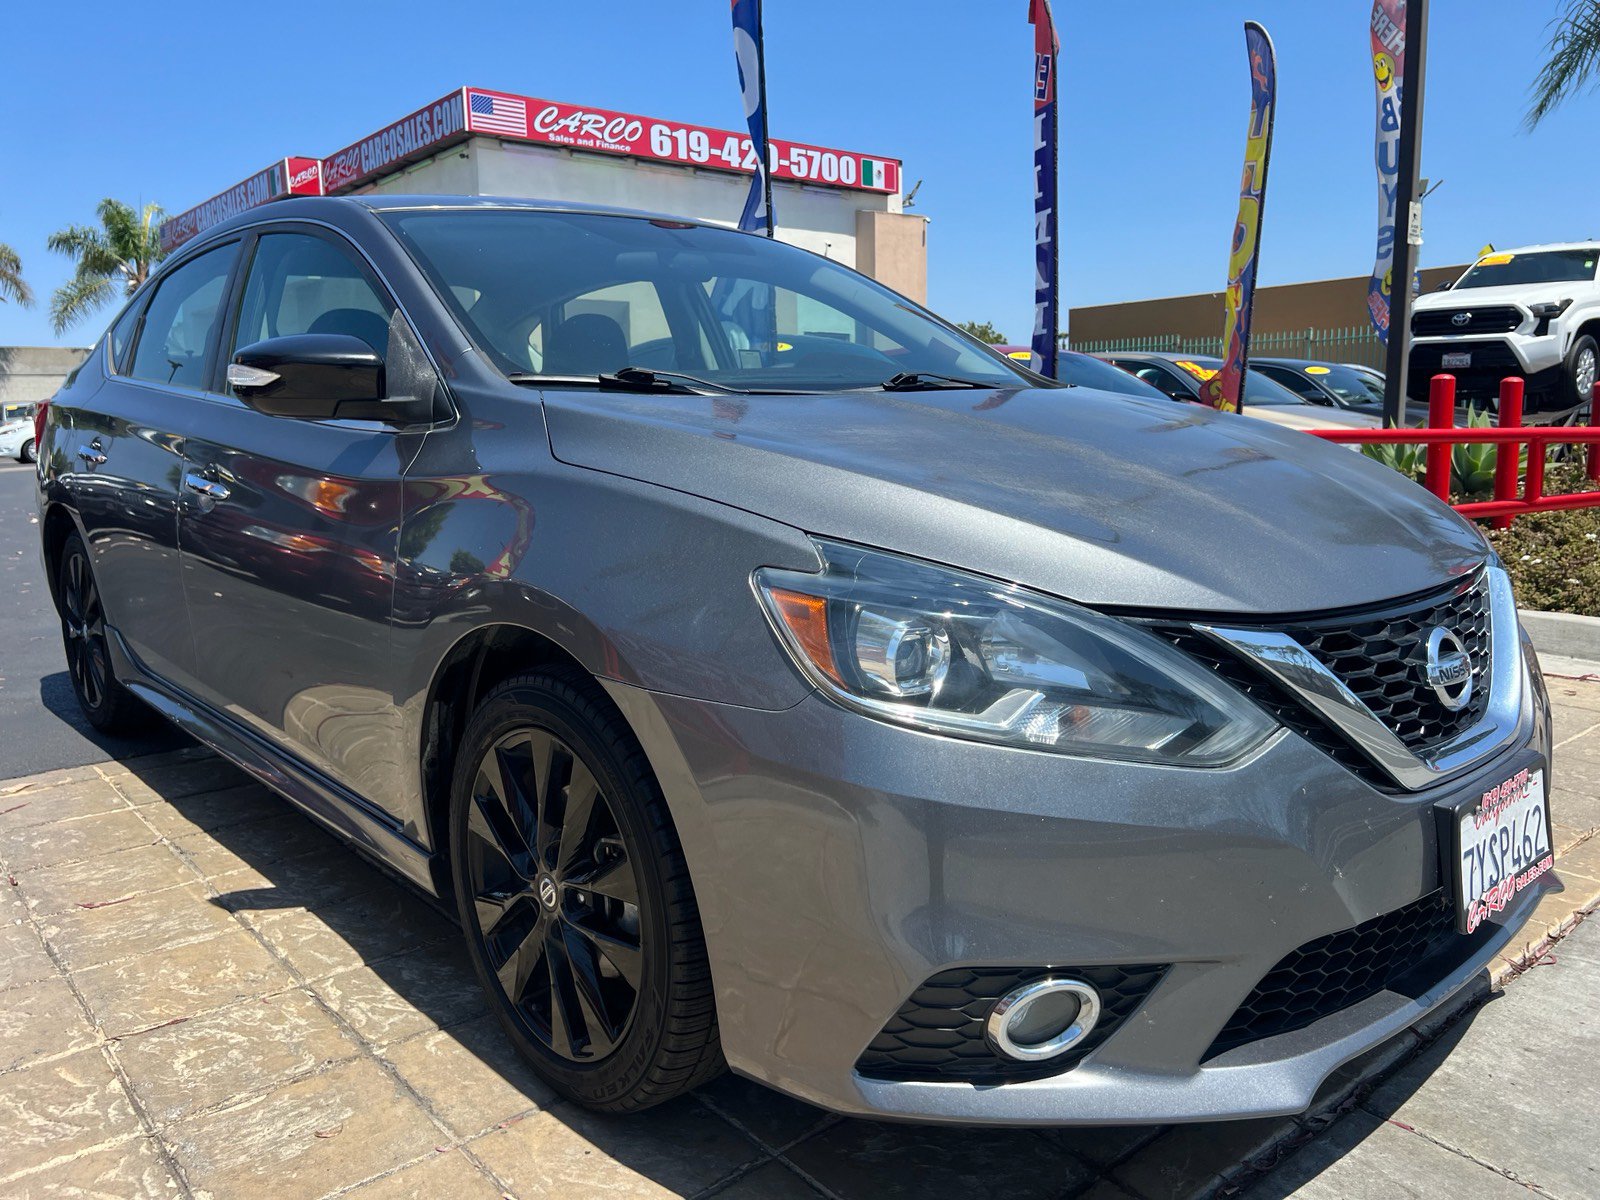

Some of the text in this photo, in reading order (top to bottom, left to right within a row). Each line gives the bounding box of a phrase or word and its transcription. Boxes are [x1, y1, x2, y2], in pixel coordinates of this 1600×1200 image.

[323, 94, 463, 187] CARCO CARCOSALES.COM
[533, 106, 643, 143] CARCO
[548, 133, 632, 152] Sales and Finance
[289, 165, 318, 188] CARCO
[1463, 804, 1546, 900] 7YSP462
[1467, 873, 1516, 935] CARCO
